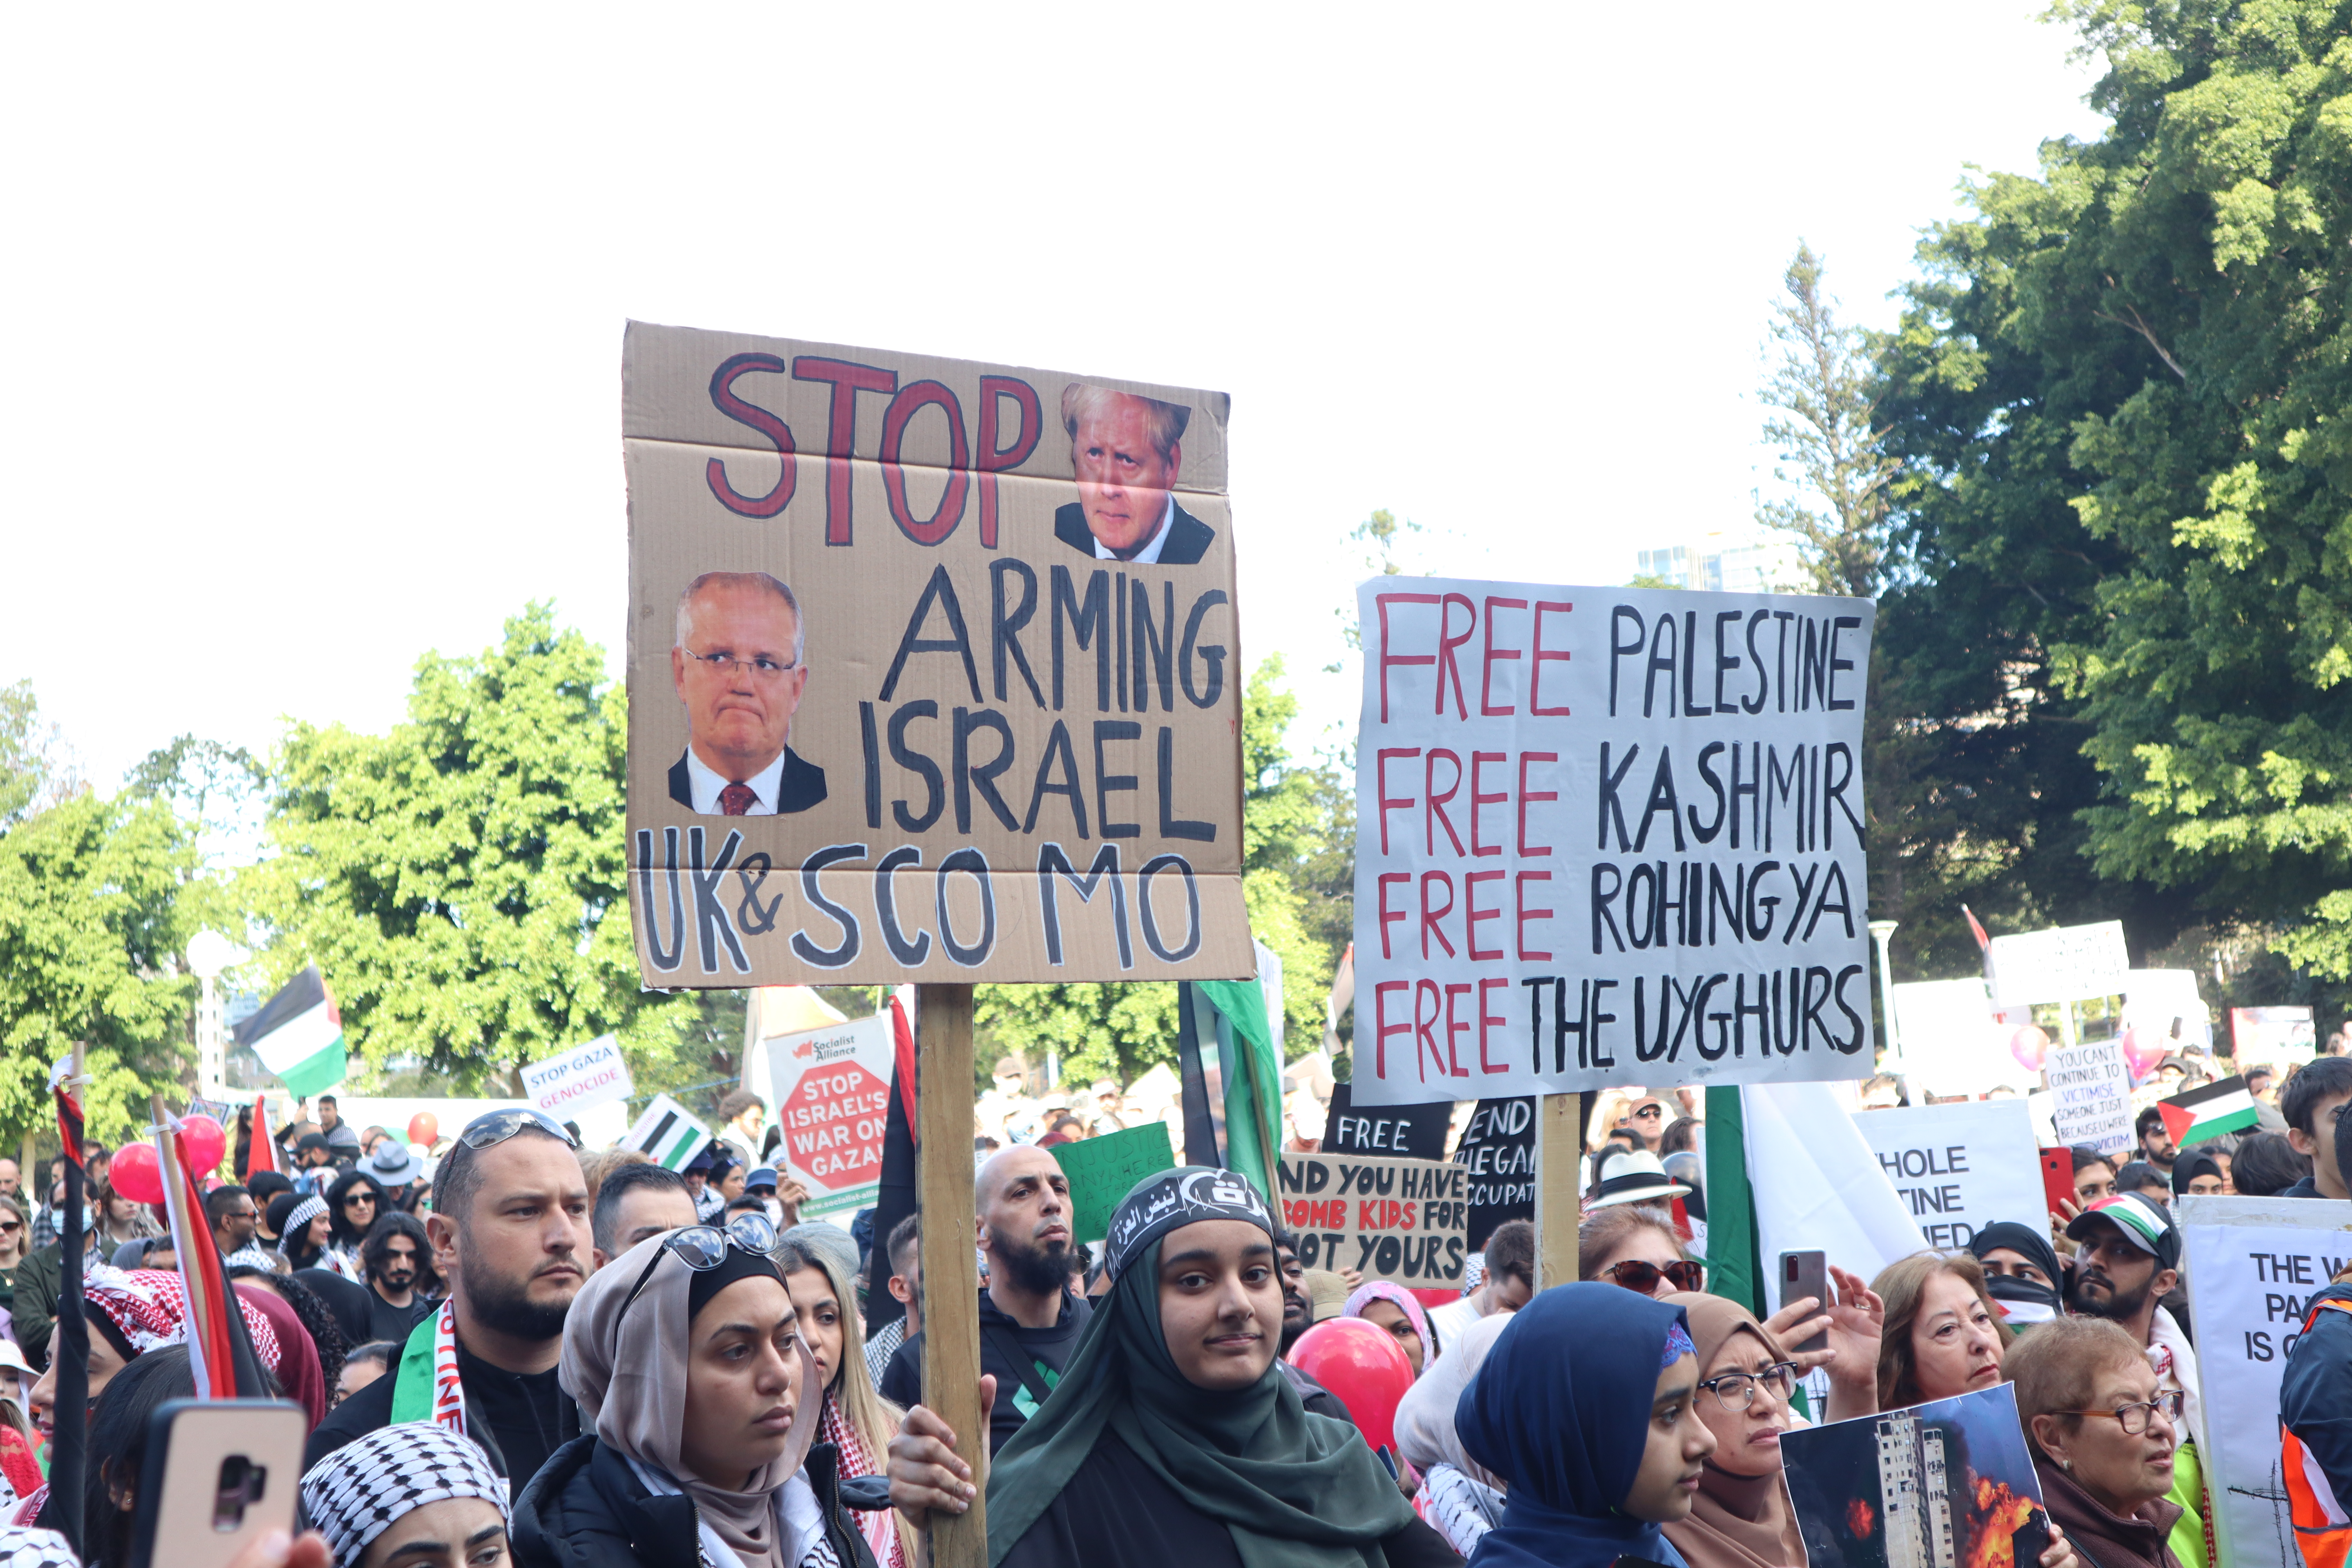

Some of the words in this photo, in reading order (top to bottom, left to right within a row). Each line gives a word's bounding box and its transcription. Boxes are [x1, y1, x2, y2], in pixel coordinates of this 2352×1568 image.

[706, 352, 1043, 549] STOP
[879, 559, 1228, 713] ARMING
[1376, 592, 1573, 724] FREE
[1609, 604, 1862, 719] PALESTINE
[859, 699, 1216, 842] ISRAEL
[1377, 747, 1558, 857] FREE
[1598, 740, 1866, 853] KASHMIR
[1377, 869, 1553, 961] FREE
[1591, 860, 1855, 955] ROHINGYA
[1375, 977, 1510, 1083] FREE
[1521, 976, 1619, 1074] THE
[1635, 964, 1864, 1063] UYGHURS
[813, 1035, 855, 1052] Socialist
[816, 1047, 856, 1062] Alliance
[2056, 1052, 2082, 1069] YOU
[531, 1064, 568, 1088] STOP
[572, 1047, 613, 1070] GAZA
[2051, 1067, 2100, 1087] CONTINUE
[2104, 1063, 2119, 1079] TO
[540, 1068, 619, 1109] GENOCIDE
[803, 1072, 862, 1101] STOP
[2062, 1082, 2116, 1103] VICTIMISE
[788, 1091, 887, 1129] ISRAEL'S
[1464, 1101, 1531, 1146] END
[2058, 1103, 2097, 1121] SOMEONE
[2100, 1098, 2122, 1114] JUST
[793, 1125, 851, 1156] WAR
[856, 1116, 887, 1141] ON
[1337, 1116, 1411, 1152] FREE
[2060, 1122, 2099, 1139] BECAUSE
[2097, 1133, 2130, 1149] VICTIM
[811, 1143, 883, 1177] GAZA!
[1054, 1128, 1170, 1173] NJUSTICE
[1875, 1145, 1969, 1178] HOLE
[1070, 1153, 1168, 1192] ANYWHERE
[1337, 1164, 1395, 1196] YOU
[1402, 1167, 1465, 1200] HAVE
[1086, 1192, 1095, 1205] A
[1100, 1178, 1143, 1198] THRE
[1282, 1199, 1347, 1230] BOMB
[1358, 1199, 1417, 1231] KIDS
[1424, 1201, 1466, 1231] FOR
[1294, 1233, 1345, 1271] OT
[1355, 1235, 1464, 1280] YOURS
[2249, 1253, 2314, 1285] THE
[2265, 1293, 2310, 1324] PA
[2245, 1331, 2274, 1363] IS
